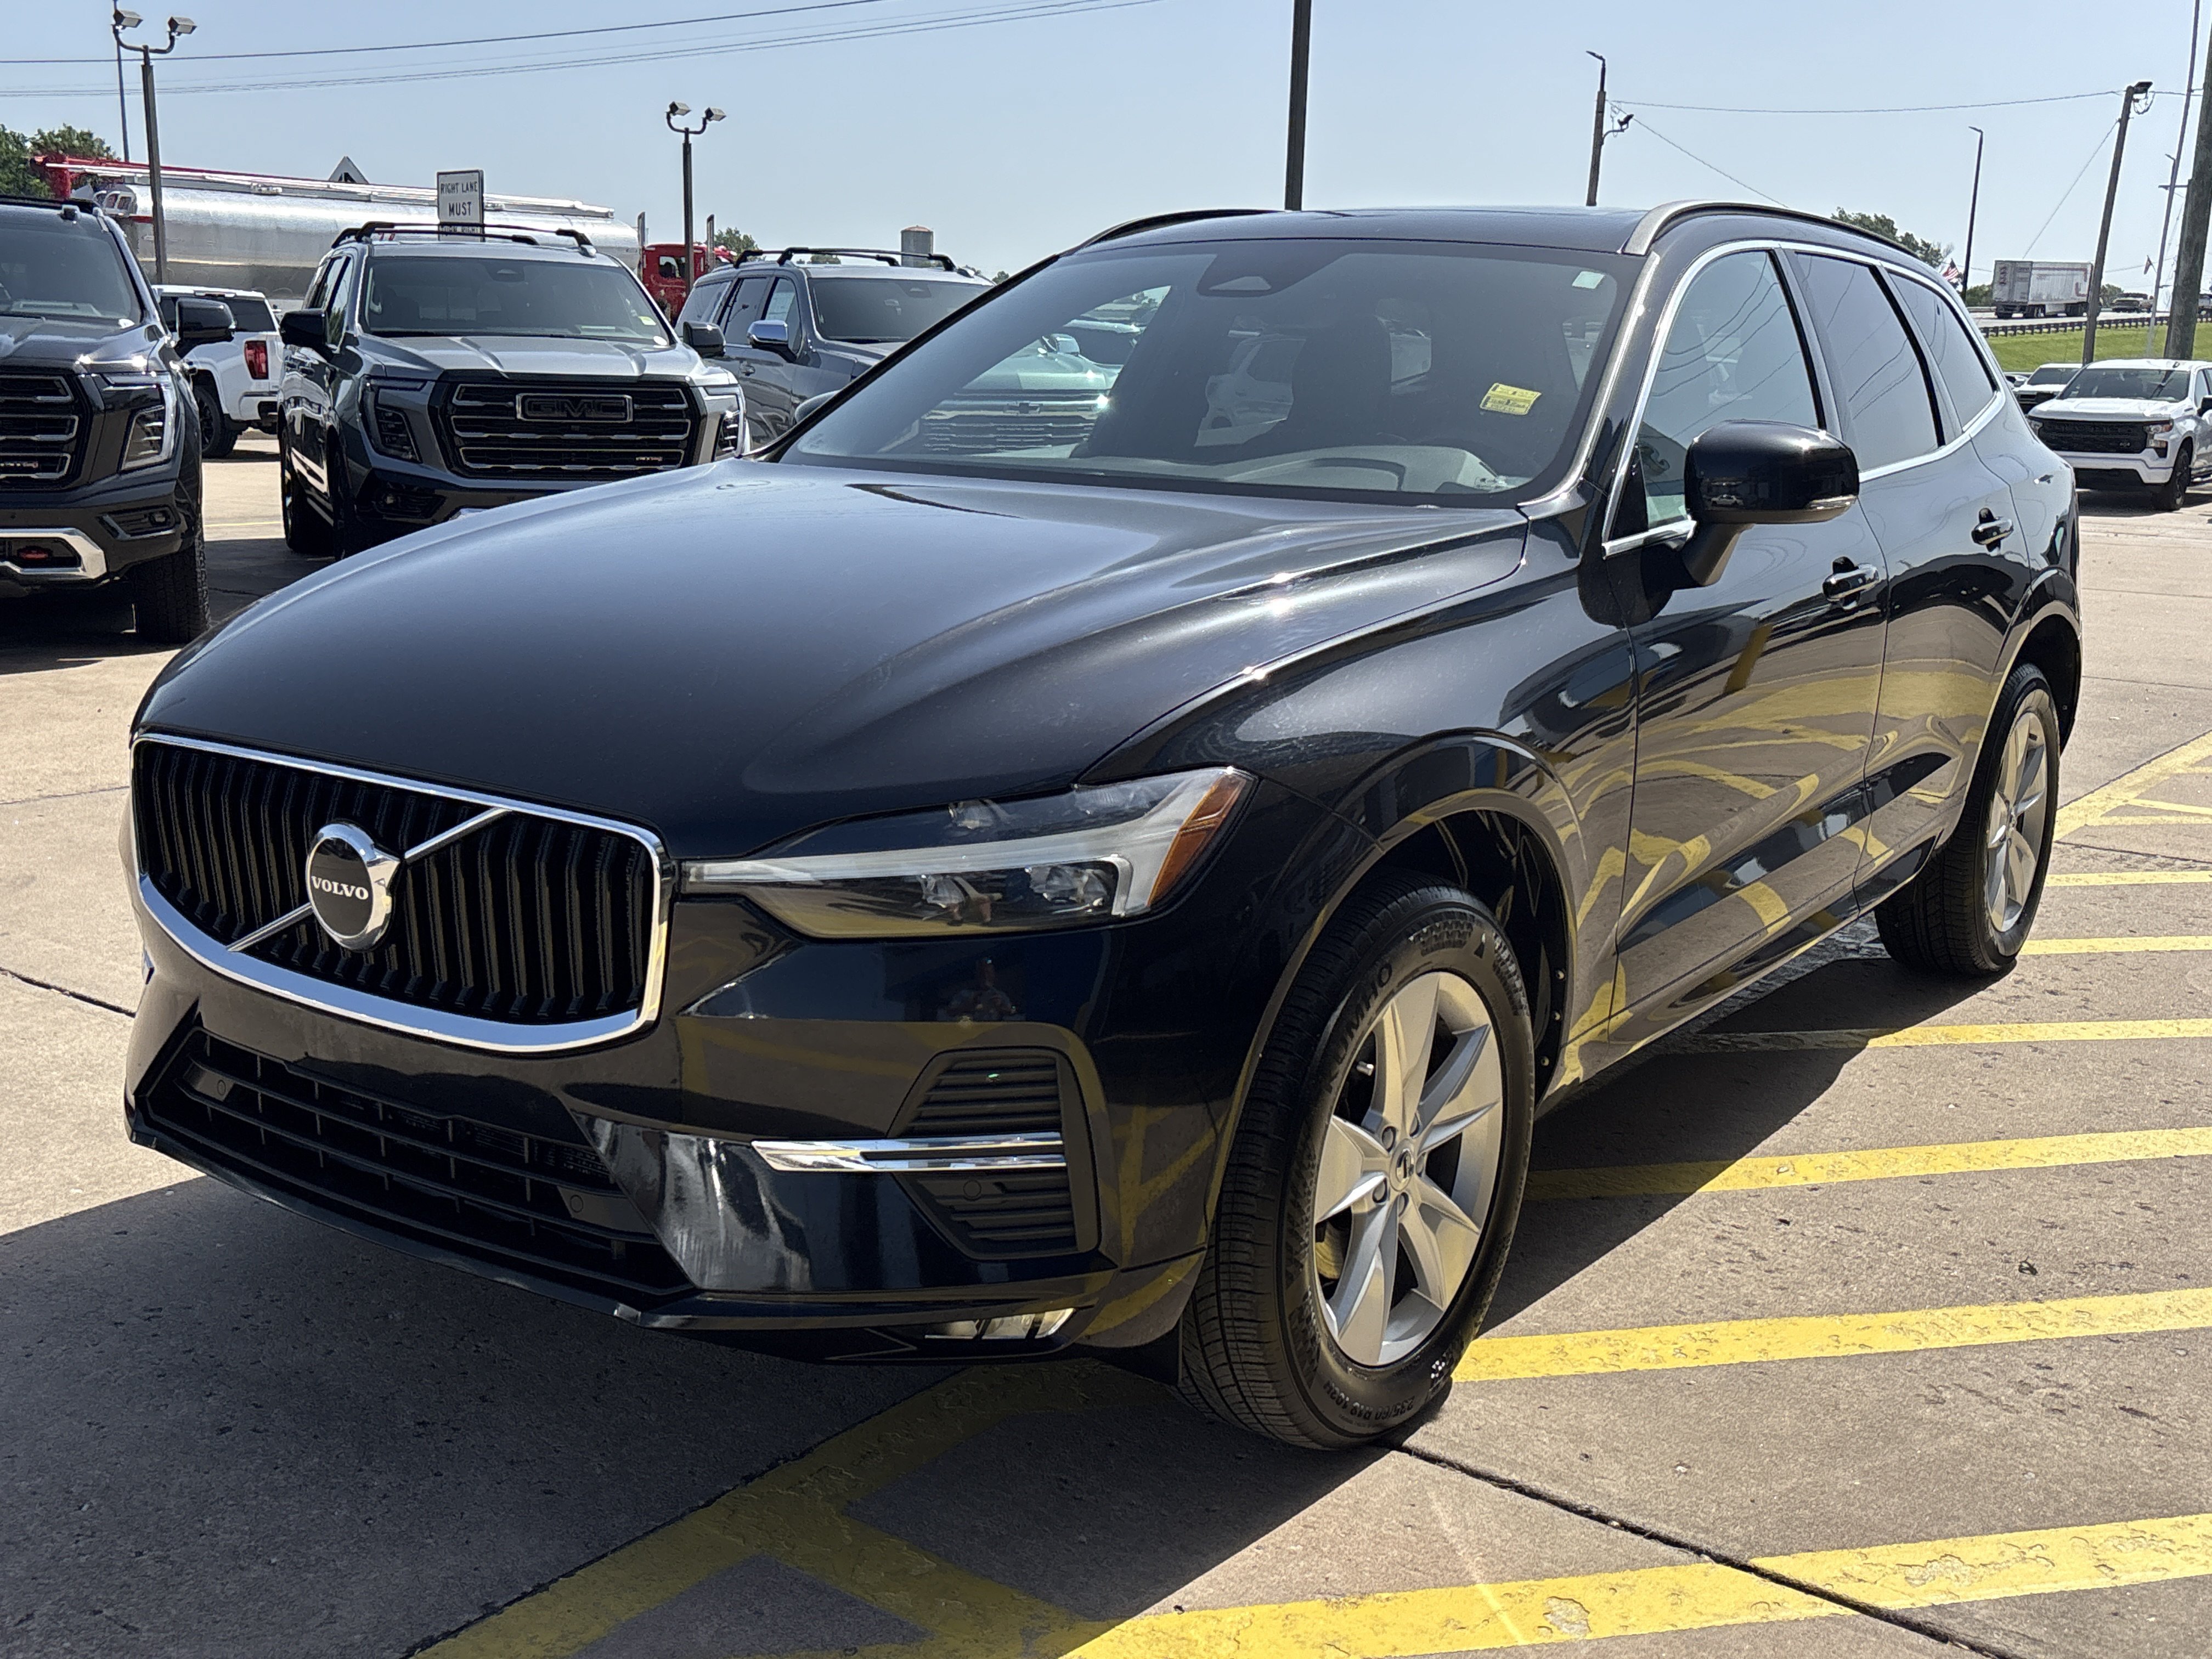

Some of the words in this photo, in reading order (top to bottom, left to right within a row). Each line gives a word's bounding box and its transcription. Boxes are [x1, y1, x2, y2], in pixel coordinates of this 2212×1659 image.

[441, 183, 459, 194] RIGHT
[461, 181, 478, 193] LANE
[449, 201, 472, 216] MUST
[524, 398, 625, 419] GMC
[311, 876, 369, 900] VOLVO
